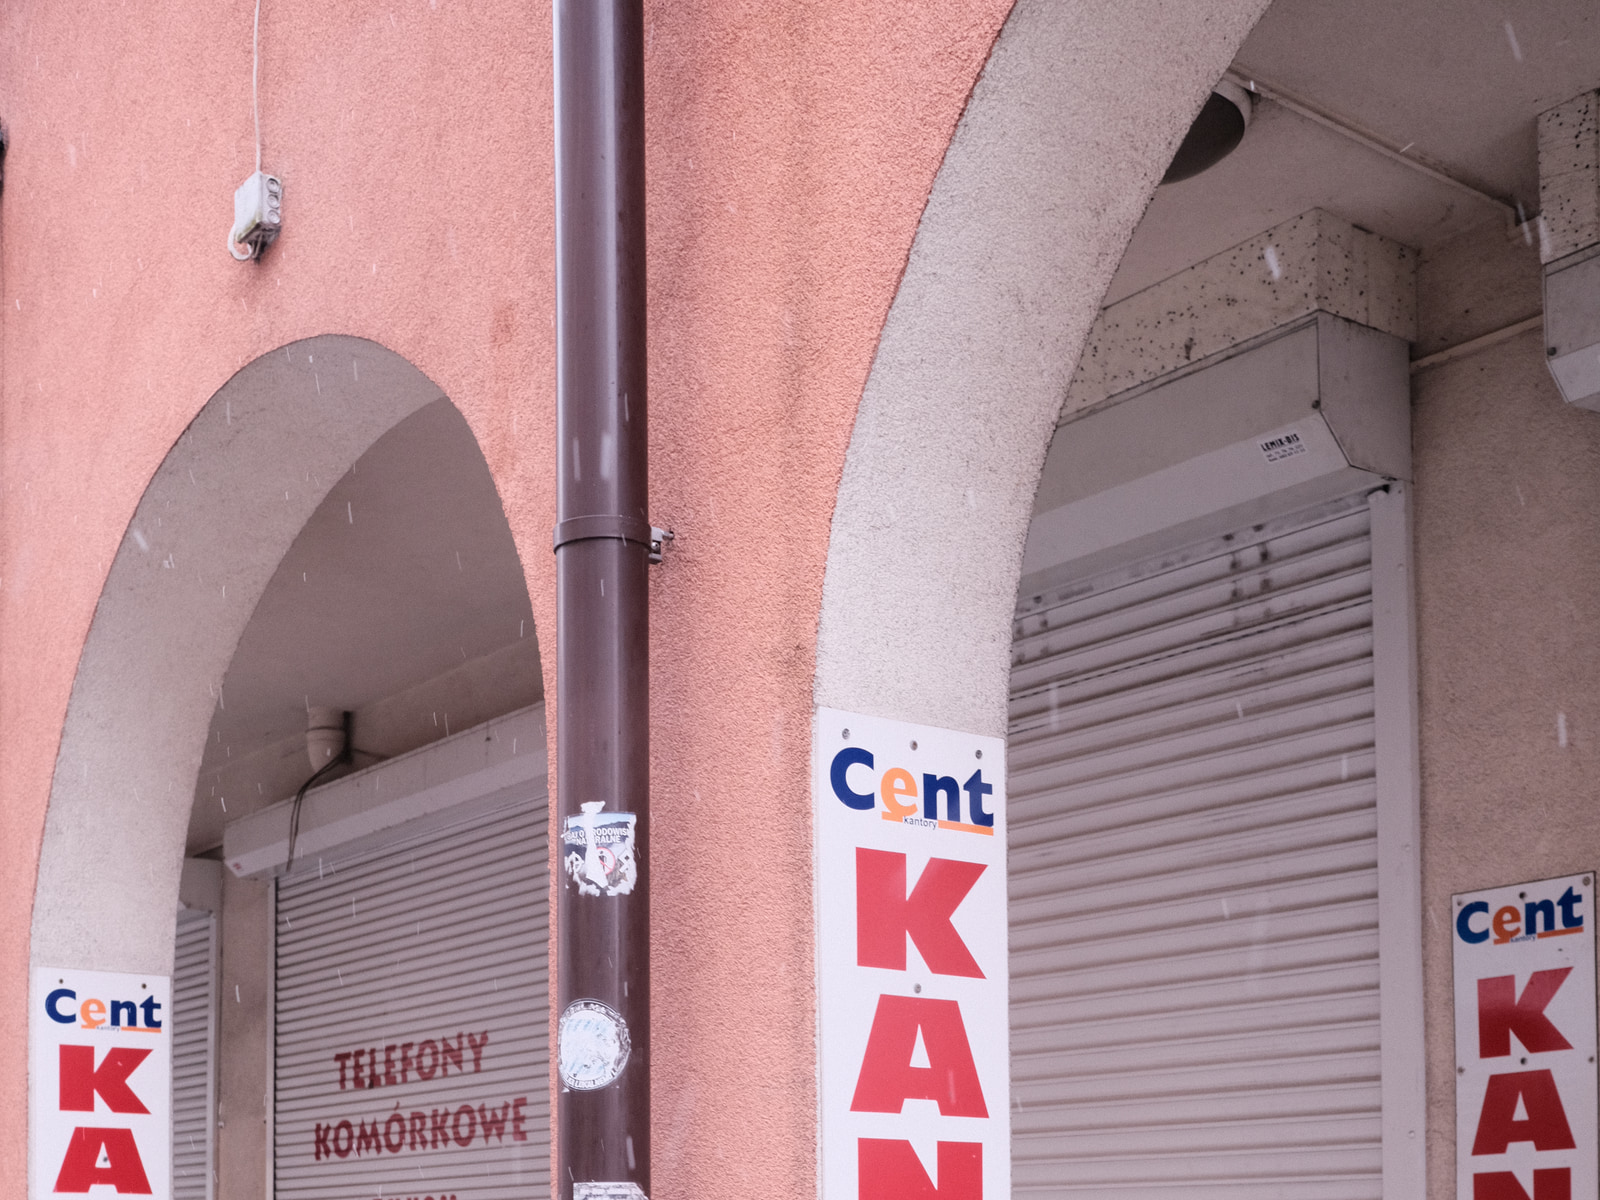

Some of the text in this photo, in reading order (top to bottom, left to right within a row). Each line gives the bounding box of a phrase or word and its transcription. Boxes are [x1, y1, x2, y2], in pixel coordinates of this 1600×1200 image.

[830, 746, 994, 828] Cent
[903, 815, 938, 830] kantory
[1456, 886, 1584, 945] Cent
[45, 988, 162, 1030] Cent
[334, 1030, 489, 1090] TELEFONY
[314, 1097, 528, 1161] KOMÓRKOWE
